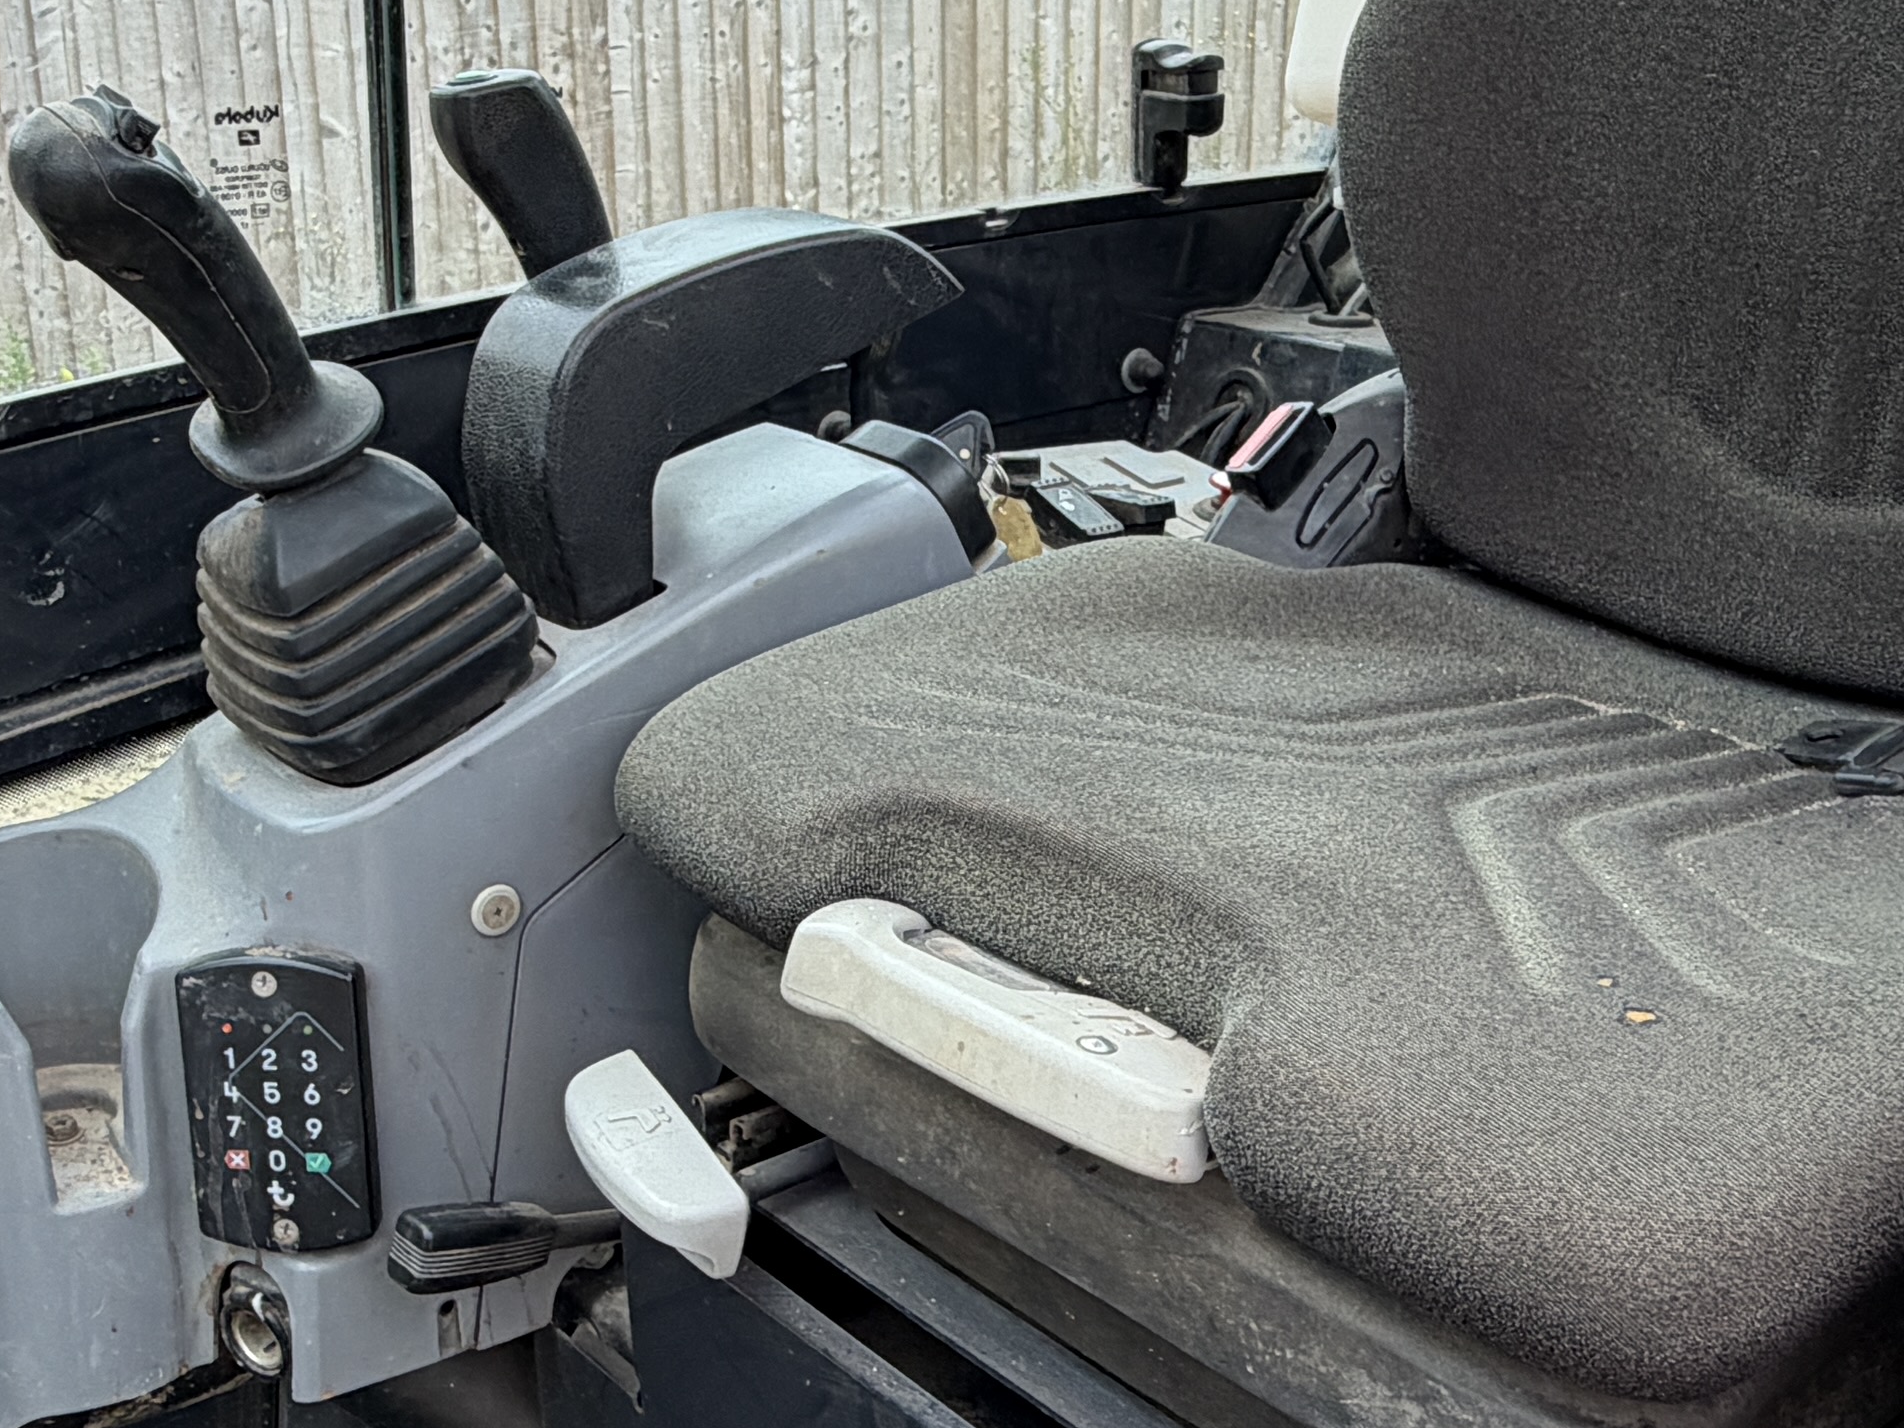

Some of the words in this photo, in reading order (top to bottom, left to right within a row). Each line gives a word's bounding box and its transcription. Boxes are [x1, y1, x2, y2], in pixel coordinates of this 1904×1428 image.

[224, 1047, 236, 1069] 1
[261, 1048, 278, 1071] 2
[301, 1050, 318, 1072] 3
[223, 1081, 240, 1103] 4
[263, 1082, 280, 1104] 5
[304, 1083, 321, 1105] 6
[226, 1115, 242, 1138] 7
[266, 1116, 283, 1139] 8
[305, 1118, 323, 1140] 9
[268, 1149, 286, 1173] 0
